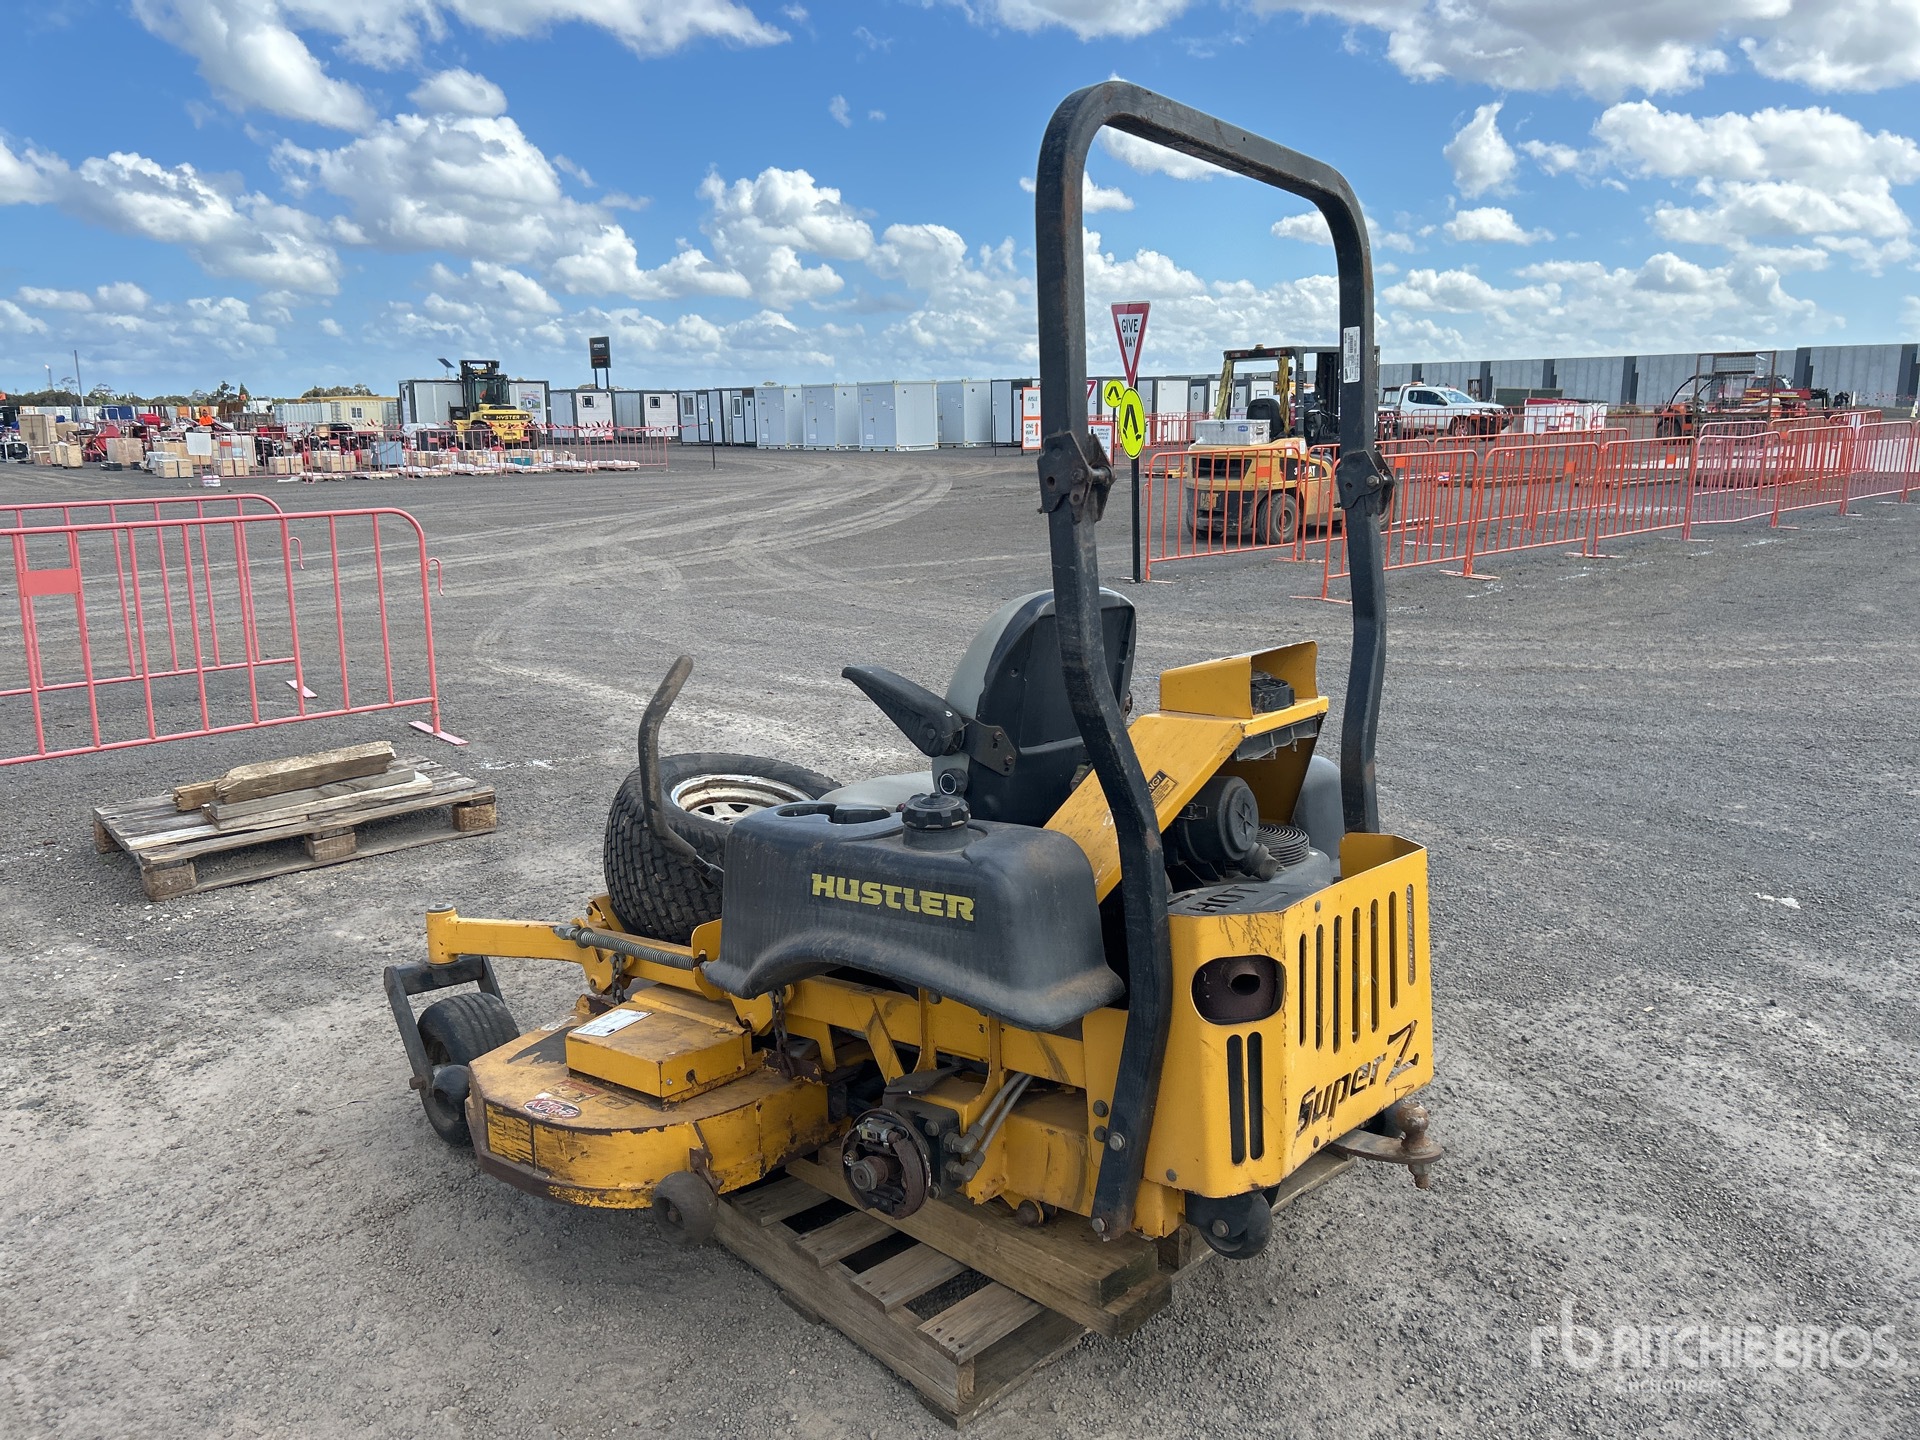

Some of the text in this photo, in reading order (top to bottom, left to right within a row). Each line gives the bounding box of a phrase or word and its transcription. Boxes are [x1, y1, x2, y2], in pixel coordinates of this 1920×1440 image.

[1121, 319, 1139, 333] GIVE
[1124, 337, 1137, 348] WAY
[1200, 492, 1219, 508] CAT
[811, 873, 974, 922] HUSTLER
[1186, 885, 1260, 913] HOT
[1384, 1018, 1420, 1087] Z
